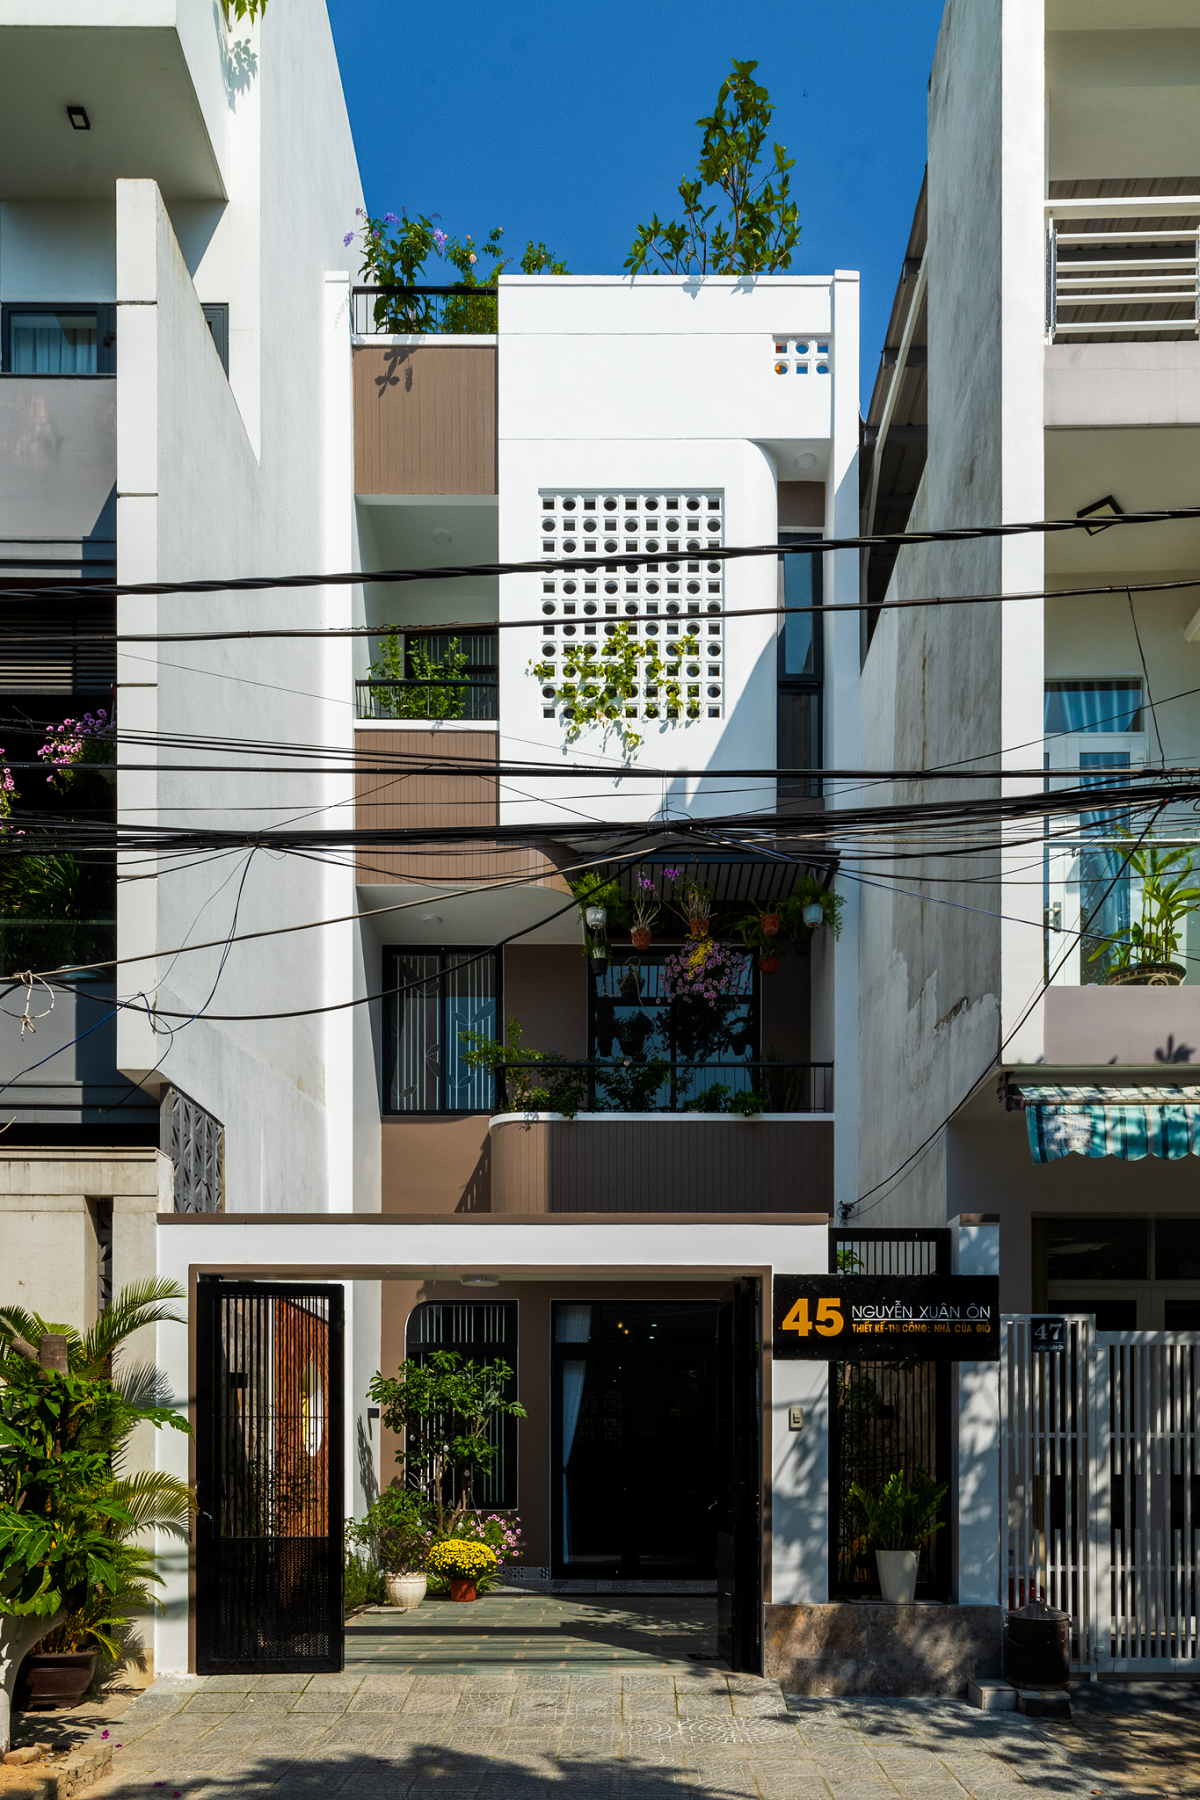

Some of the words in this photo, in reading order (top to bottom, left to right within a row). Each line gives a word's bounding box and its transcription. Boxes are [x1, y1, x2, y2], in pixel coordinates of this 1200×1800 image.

[782, 1298, 844, 1337] 45
[852, 1300, 913, 1318] NGUYỄN
[919, 1302, 960, 1319] XUÂN
[966, 1302, 990, 1319] ÔN
[852, 1320, 872, 1333] THIẾT
[934, 1321, 951, 1333] NHÀ
[954, 1321, 972, 1333] CỦA
[976, 1321, 991, 1333] GIÓ
[1034, 1323, 1063, 1340] 47
